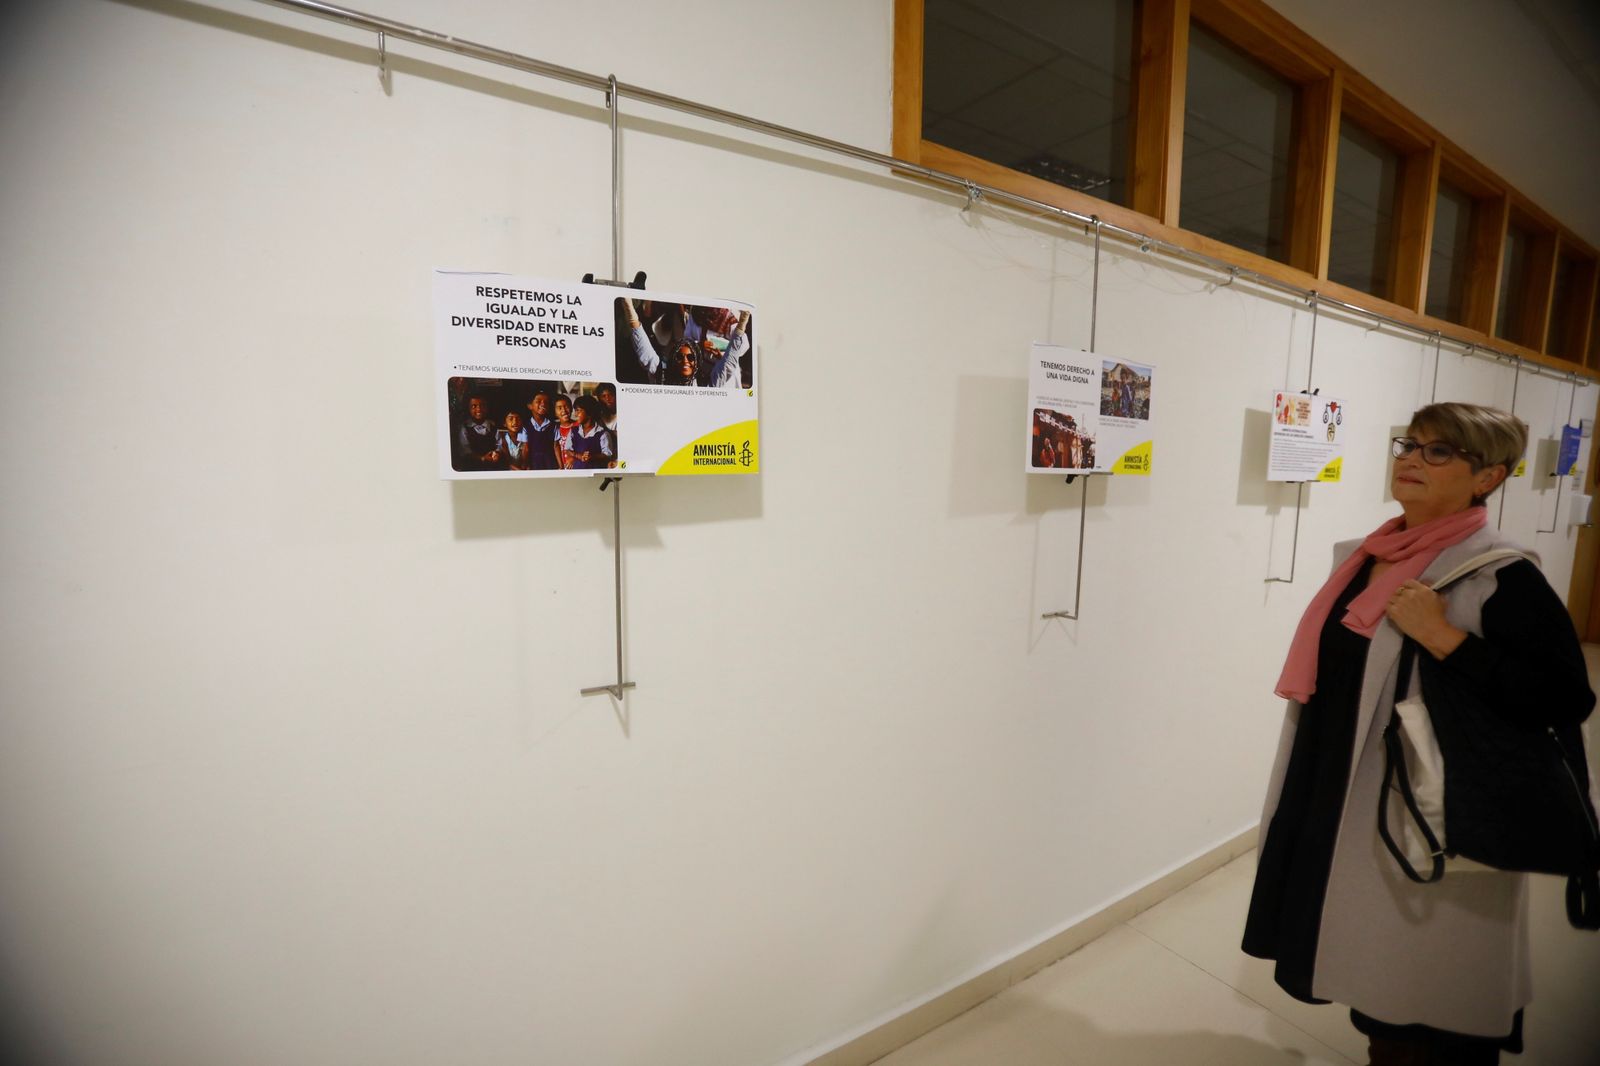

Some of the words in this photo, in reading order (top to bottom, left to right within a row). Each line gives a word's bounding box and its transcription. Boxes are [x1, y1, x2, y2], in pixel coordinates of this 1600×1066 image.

[476, 286, 563, 304] RESPETEMOS
[566, 295, 582, 306] LA
[486, 302, 546, 317] IGUALAD
[550, 309, 558, 318] Y
[562, 310, 578, 320] LA
[451, 315, 534, 332] DIVERSIDAD
[538, 322, 579, 335] ENTRE
[582, 326, 604, 337] LAS
[496, 334, 566, 349] PERSONAS
[458, 364, 490, 372] TENEMOS
[491, 366, 518, 374] IGUALES
[519, 367, 553, 375] DERECHOS
[559, 369, 592, 377] LIBERTADES
[1040, 360, 1066, 371] TENEMOS
[1066, 365, 1090, 375] DERECHO
[1072, 376, 1089, 384] DIGNA
[693, 442, 736, 456] AMNISTÍA
[693, 458, 736, 466] INTERNACIONAL
